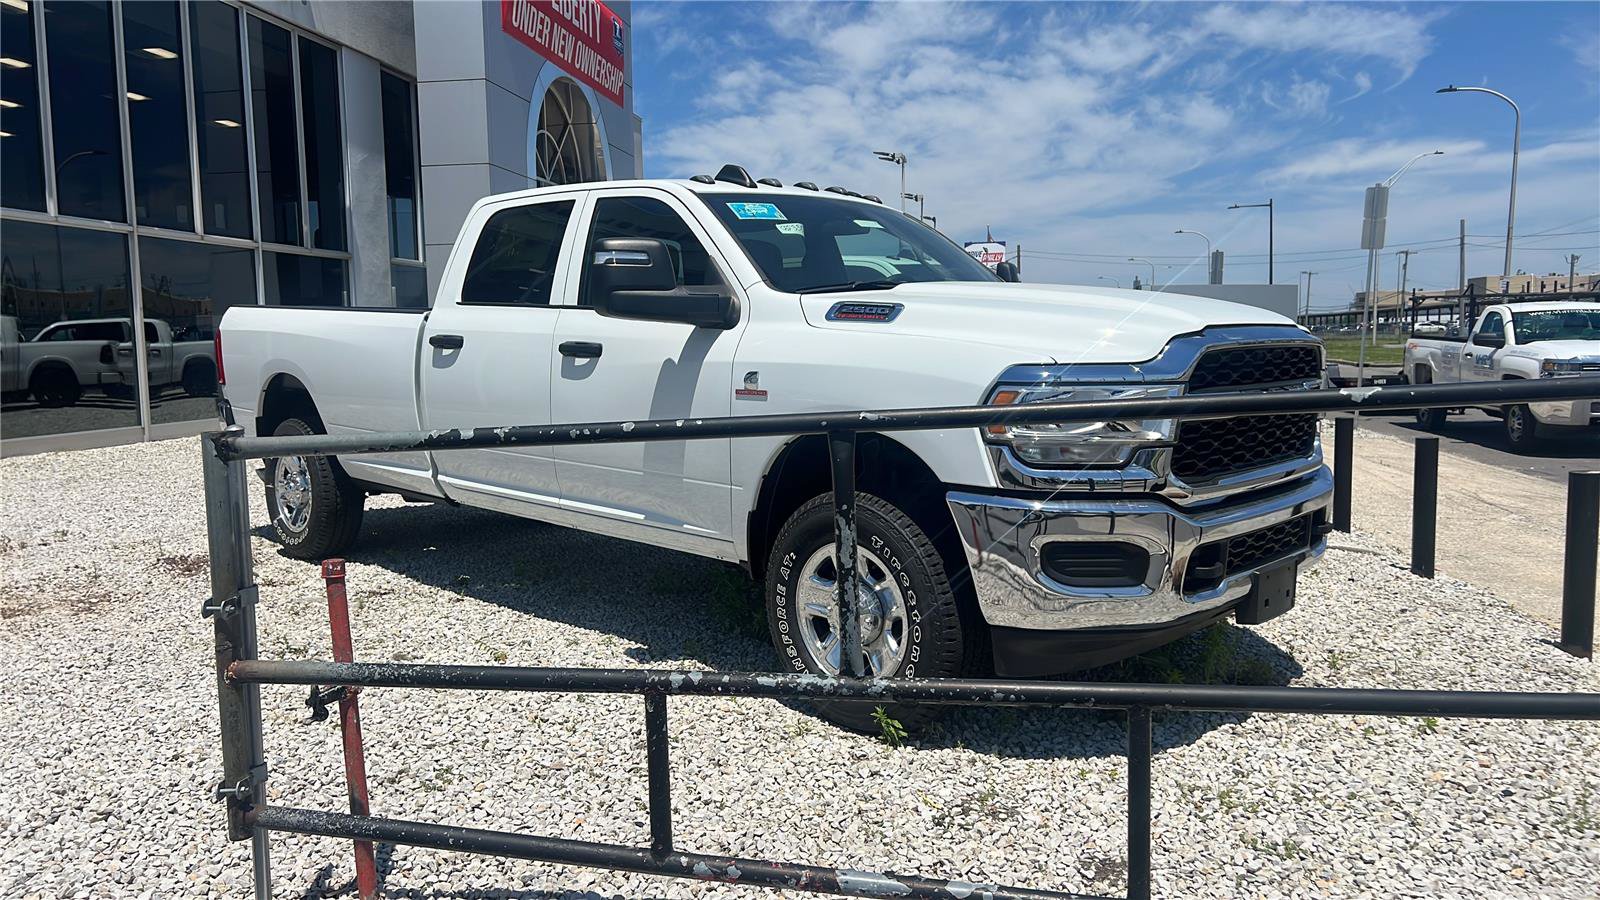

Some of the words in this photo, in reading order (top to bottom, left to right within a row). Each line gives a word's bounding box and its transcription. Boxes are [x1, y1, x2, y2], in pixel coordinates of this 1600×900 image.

[511, 0, 551, 48] UNDER
[550, 22, 576, 64] NEW
[574, 40, 624, 96] OWNERSHIP
[551, 0, 601, 43] ERTY
[840, 305, 890, 315] 2500
[775, 583, 810, 675] NSFORCE
[871, 535, 922, 679] Firestone
